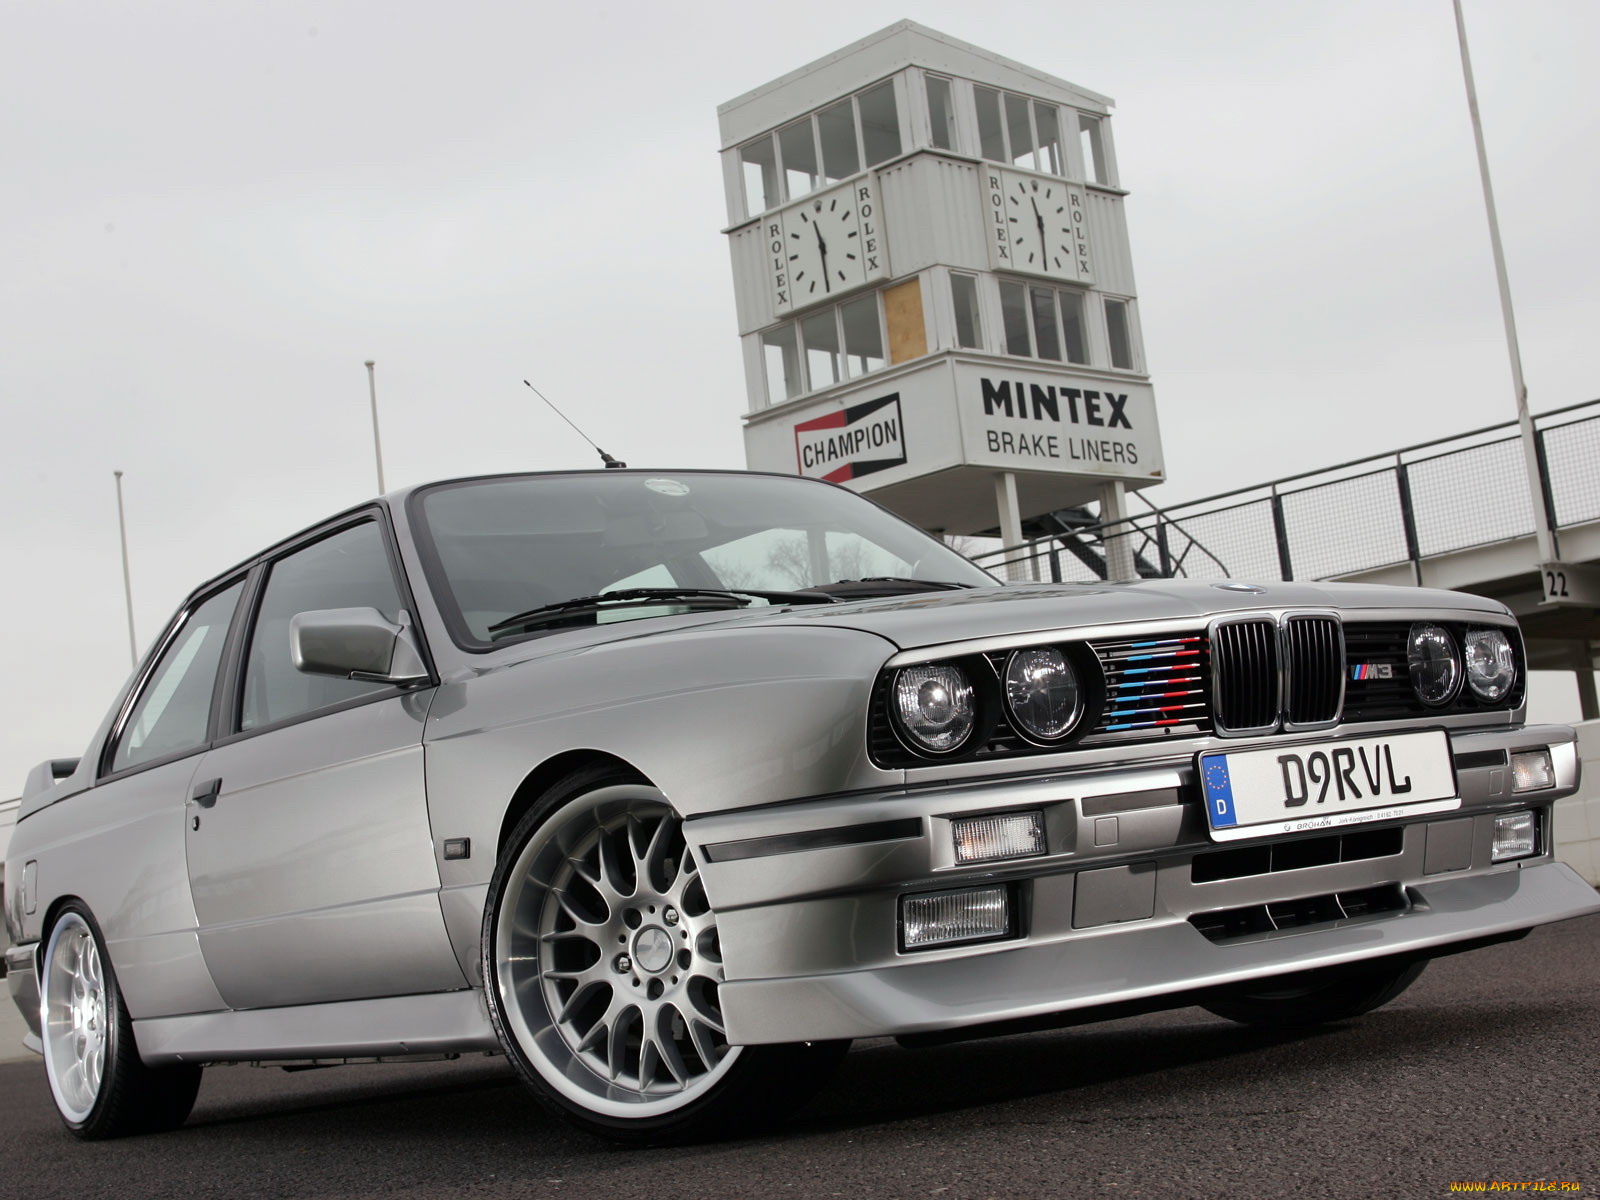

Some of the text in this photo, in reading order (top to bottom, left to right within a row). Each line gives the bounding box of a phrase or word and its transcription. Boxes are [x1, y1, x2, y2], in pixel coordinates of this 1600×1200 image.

[859, 187, 879, 271] ROLEX
[990, 176, 1008, 259] ROLEX
[1070, 194, 1089, 273] ROLEX
[769, 224, 787, 304] ROLEX
[980, 377, 1133, 430] MINTEX
[803, 418, 897, 468] CHAMPION
[986, 429, 1138, 465] BRAKE LINERS
[1546, 571, 1569, 597] 22
[1364, 663, 1393, 680] M3
[1278, 743, 1412, 808] D9RVL
[1216, 798, 1227, 815] D
